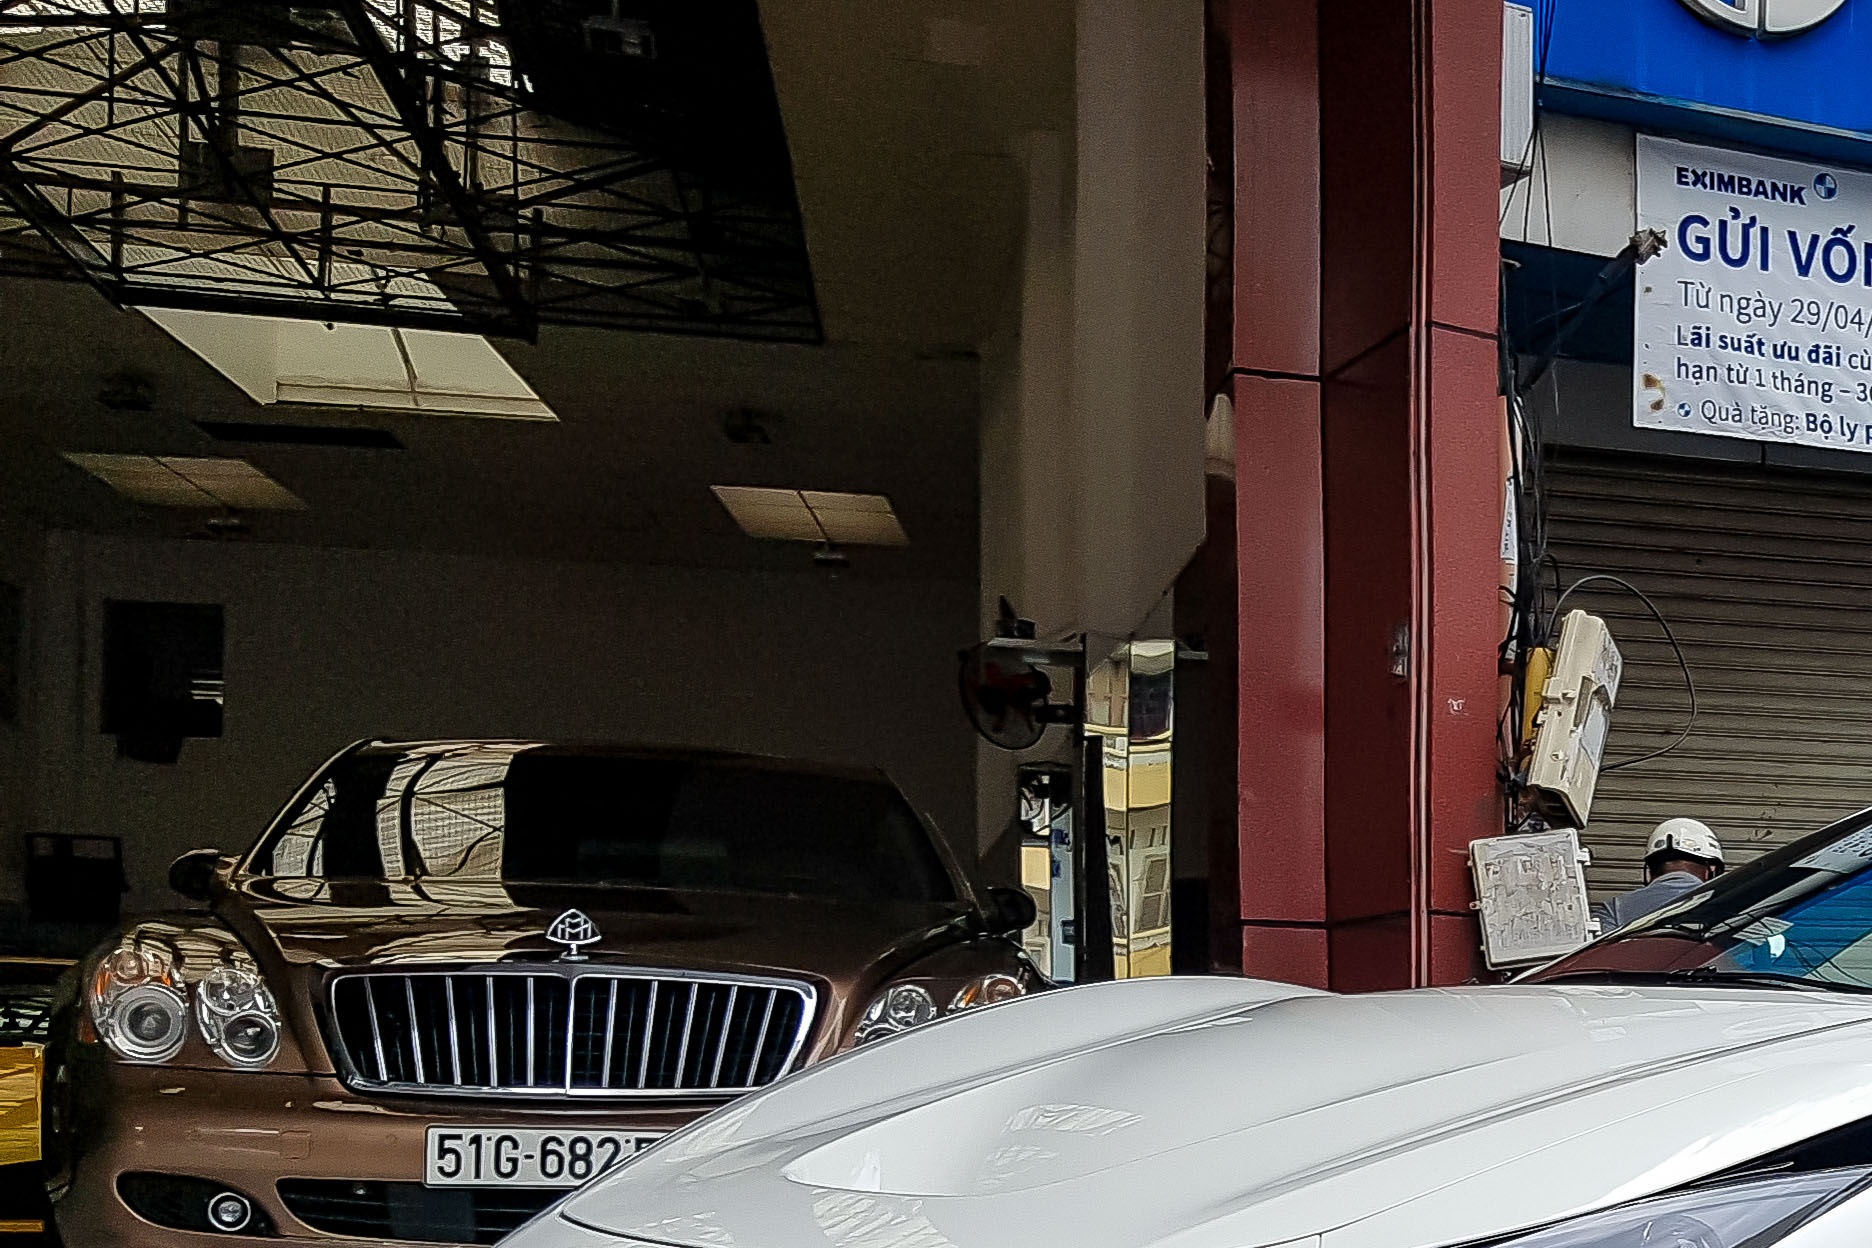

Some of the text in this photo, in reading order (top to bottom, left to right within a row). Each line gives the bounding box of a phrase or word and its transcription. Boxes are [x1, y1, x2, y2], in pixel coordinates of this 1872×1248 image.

[1675, 166, 1806, 206] EXIMBANK
[1676, 206, 1771, 273] GỬI
[1677, 280, 1712, 310] Từ
[1719, 290, 1783, 328] ngày
[1676, 324, 1712, 349] Lãi
[1718, 332, 1766, 358] suất
[1772, 340, 1800, 362] ưu
[1807, 343, 1842, 368] đãi
[1676, 356, 1718, 386] hạn
[1725, 363, 1749, 385] từ
[1754, 368, 1767, 388] 1
[1771, 369, 1835, 404] tháng
[1700, 399, 1743, 425] Quà
[1750, 404, 1801, 434] tặng:
[1804, 412, 1833, 440] Bộ
[1839, 415, 1858, 443] ly
